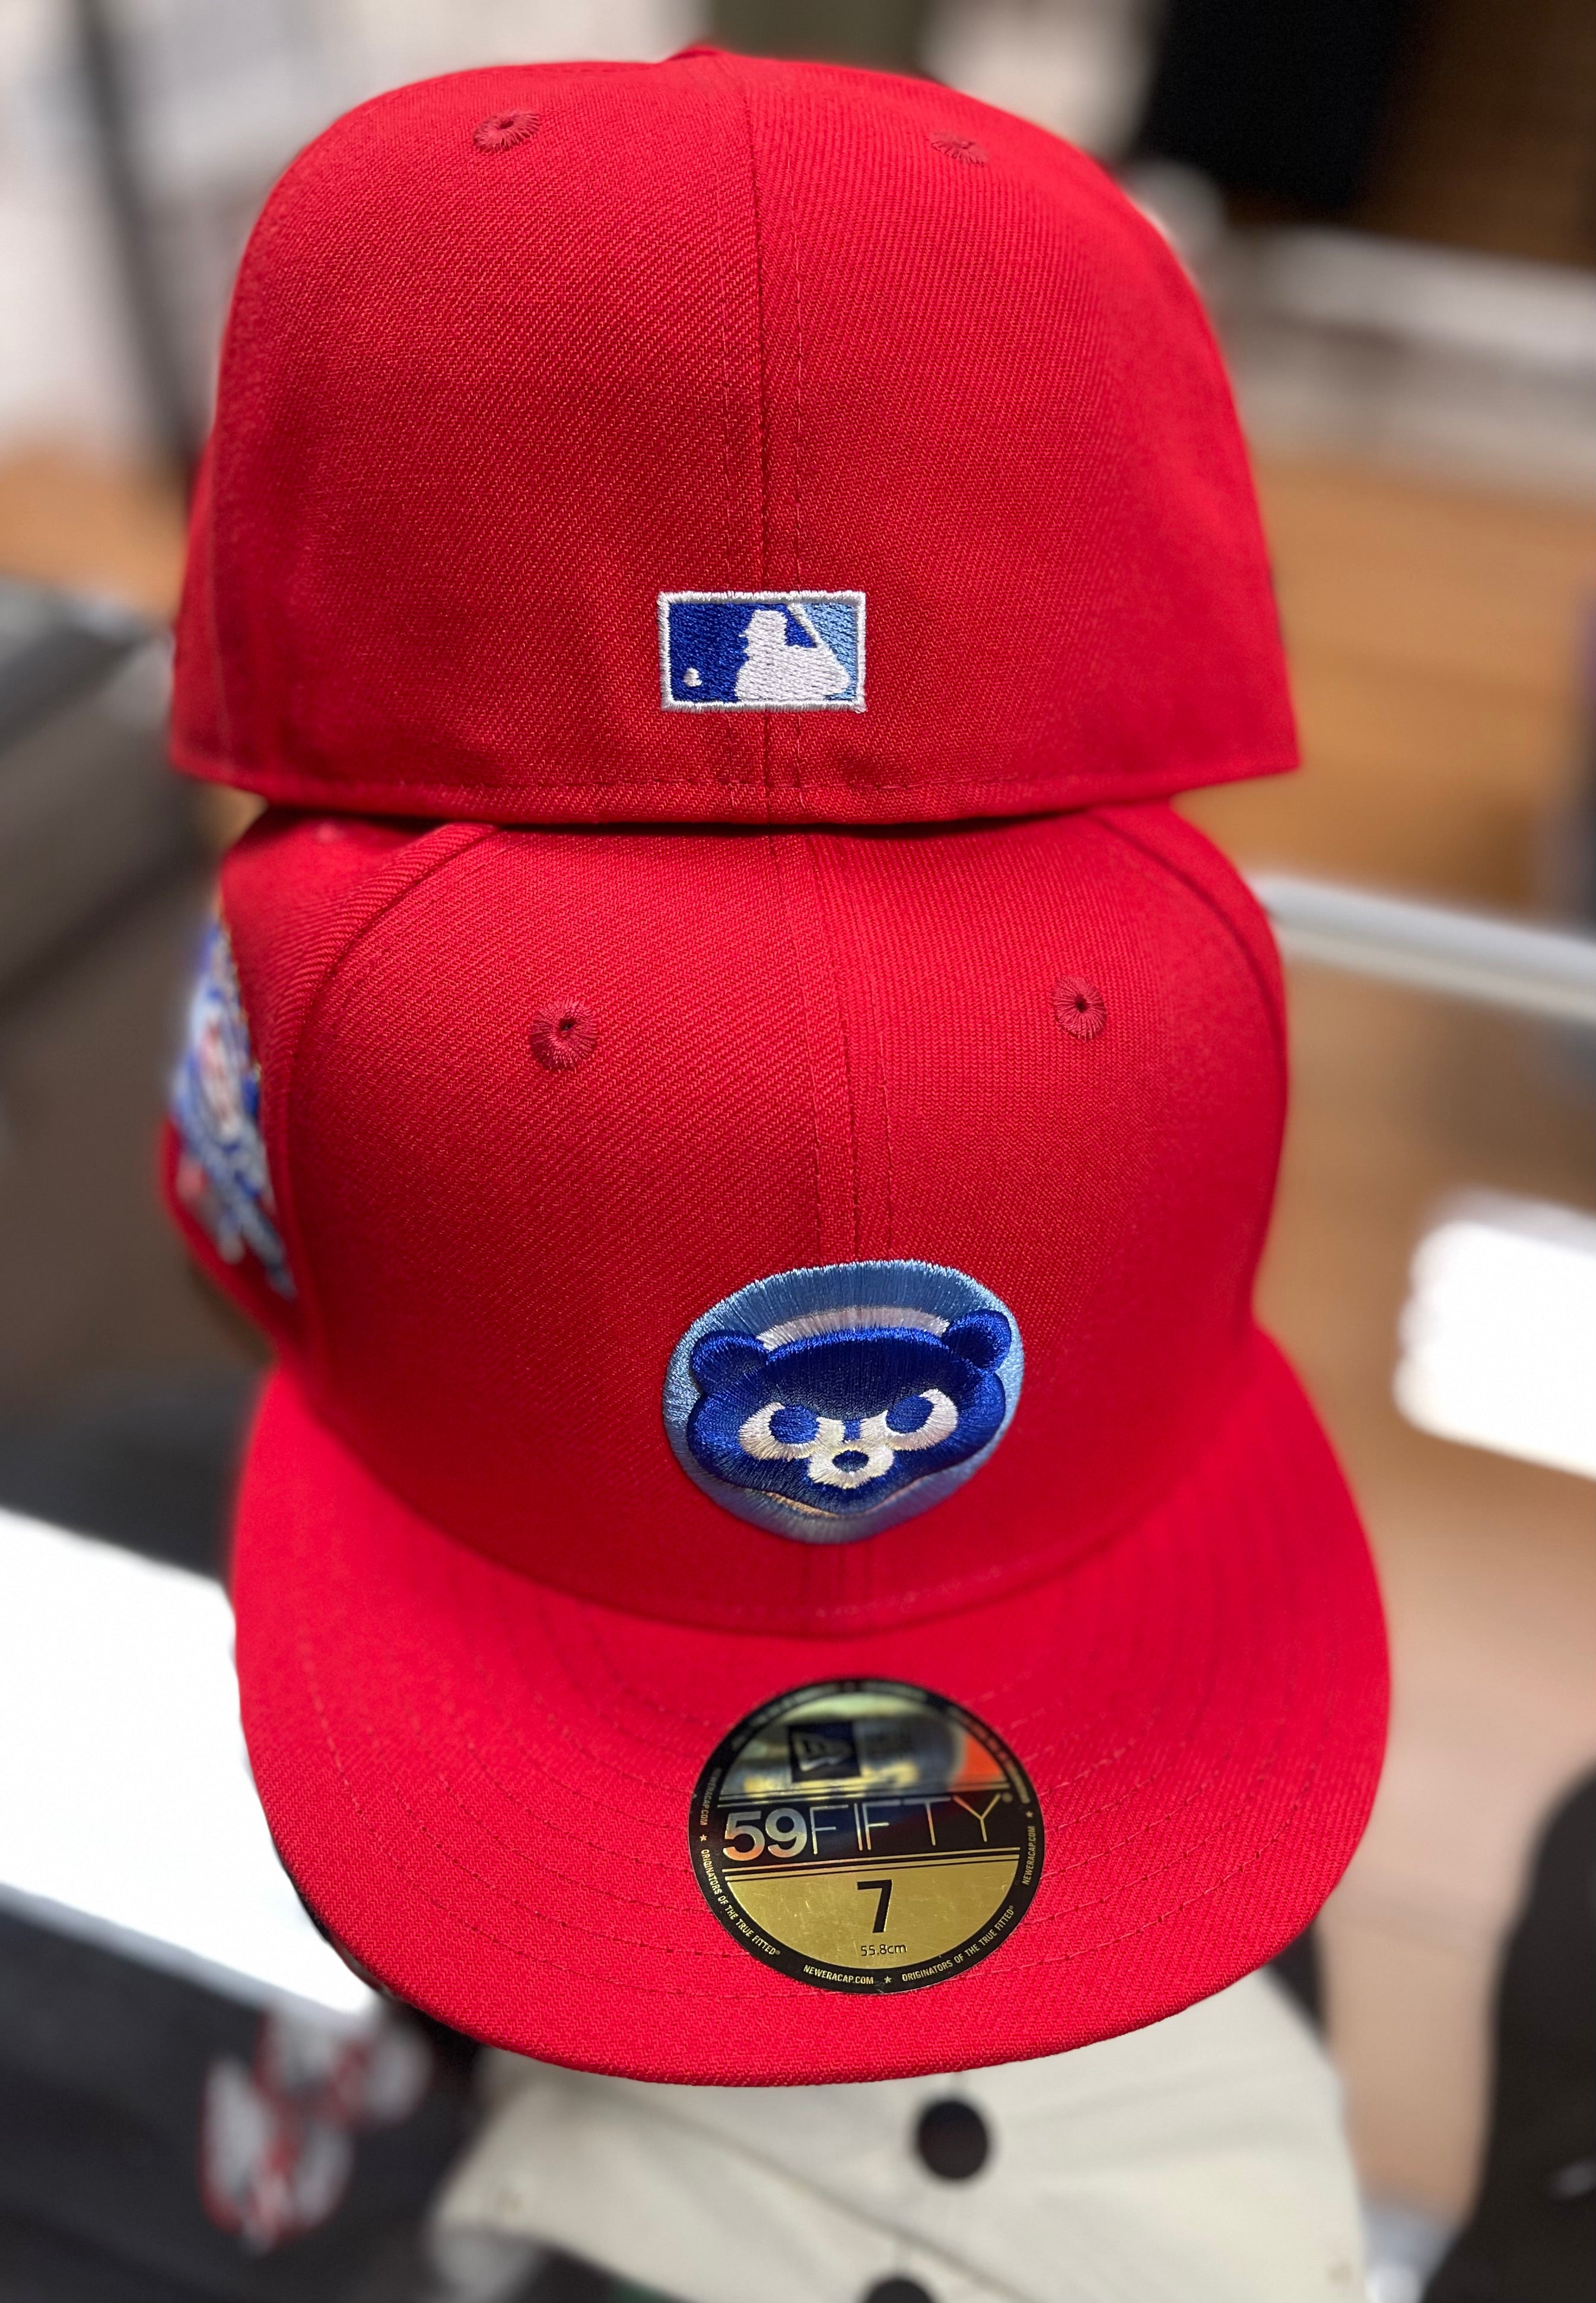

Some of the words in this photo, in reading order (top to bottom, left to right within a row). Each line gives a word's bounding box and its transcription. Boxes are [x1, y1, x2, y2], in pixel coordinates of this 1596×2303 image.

[723, 1793, 1001, 1862] 59FIFTY
[1022, 1825, 1036, 1885] NEWERACAP.COM
[701, 1849, 723, 1895] ORIGINATORS
[718, 1895, 729, 1905] OF
[724, 1904, 739, 1920] THE
[736, 1918, 754, 1938] TRUE
[857, 1879, 892, 1933] 7
[803, 1964, 875, 1984] NEWERACAP.COM
[861, 1943, 908, 1957] 55.8cm
[902, 1960, 953, 1982] ORIGINATORS
[953, 1953, 964, 1964] OF
[964, 1943, 981, 1957] THE
[978, 1929, 997, 1946] TRUE
